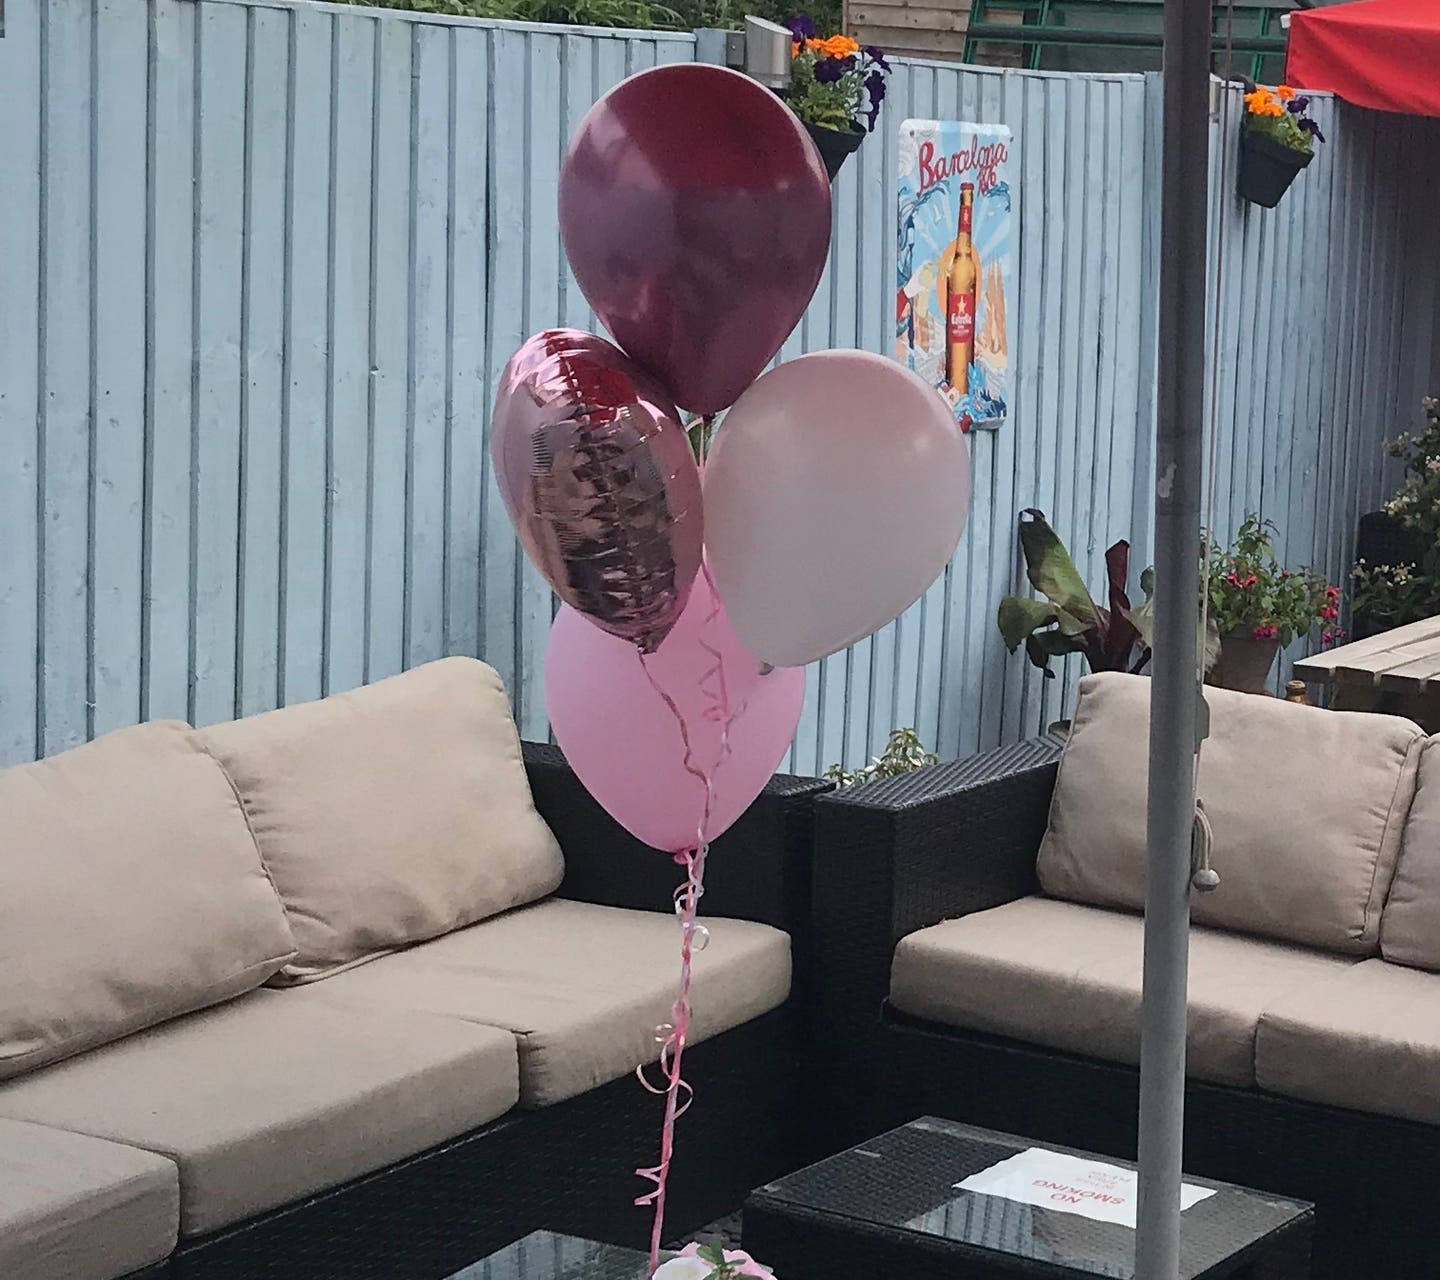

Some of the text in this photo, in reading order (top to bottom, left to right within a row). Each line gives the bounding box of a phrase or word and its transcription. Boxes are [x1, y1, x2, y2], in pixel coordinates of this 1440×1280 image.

[916, 133, 1008, 198] Barcelona
[1032, 1179, 1126, 1205] SMOKING
[1050, 1193, 1081, 1204] NO
